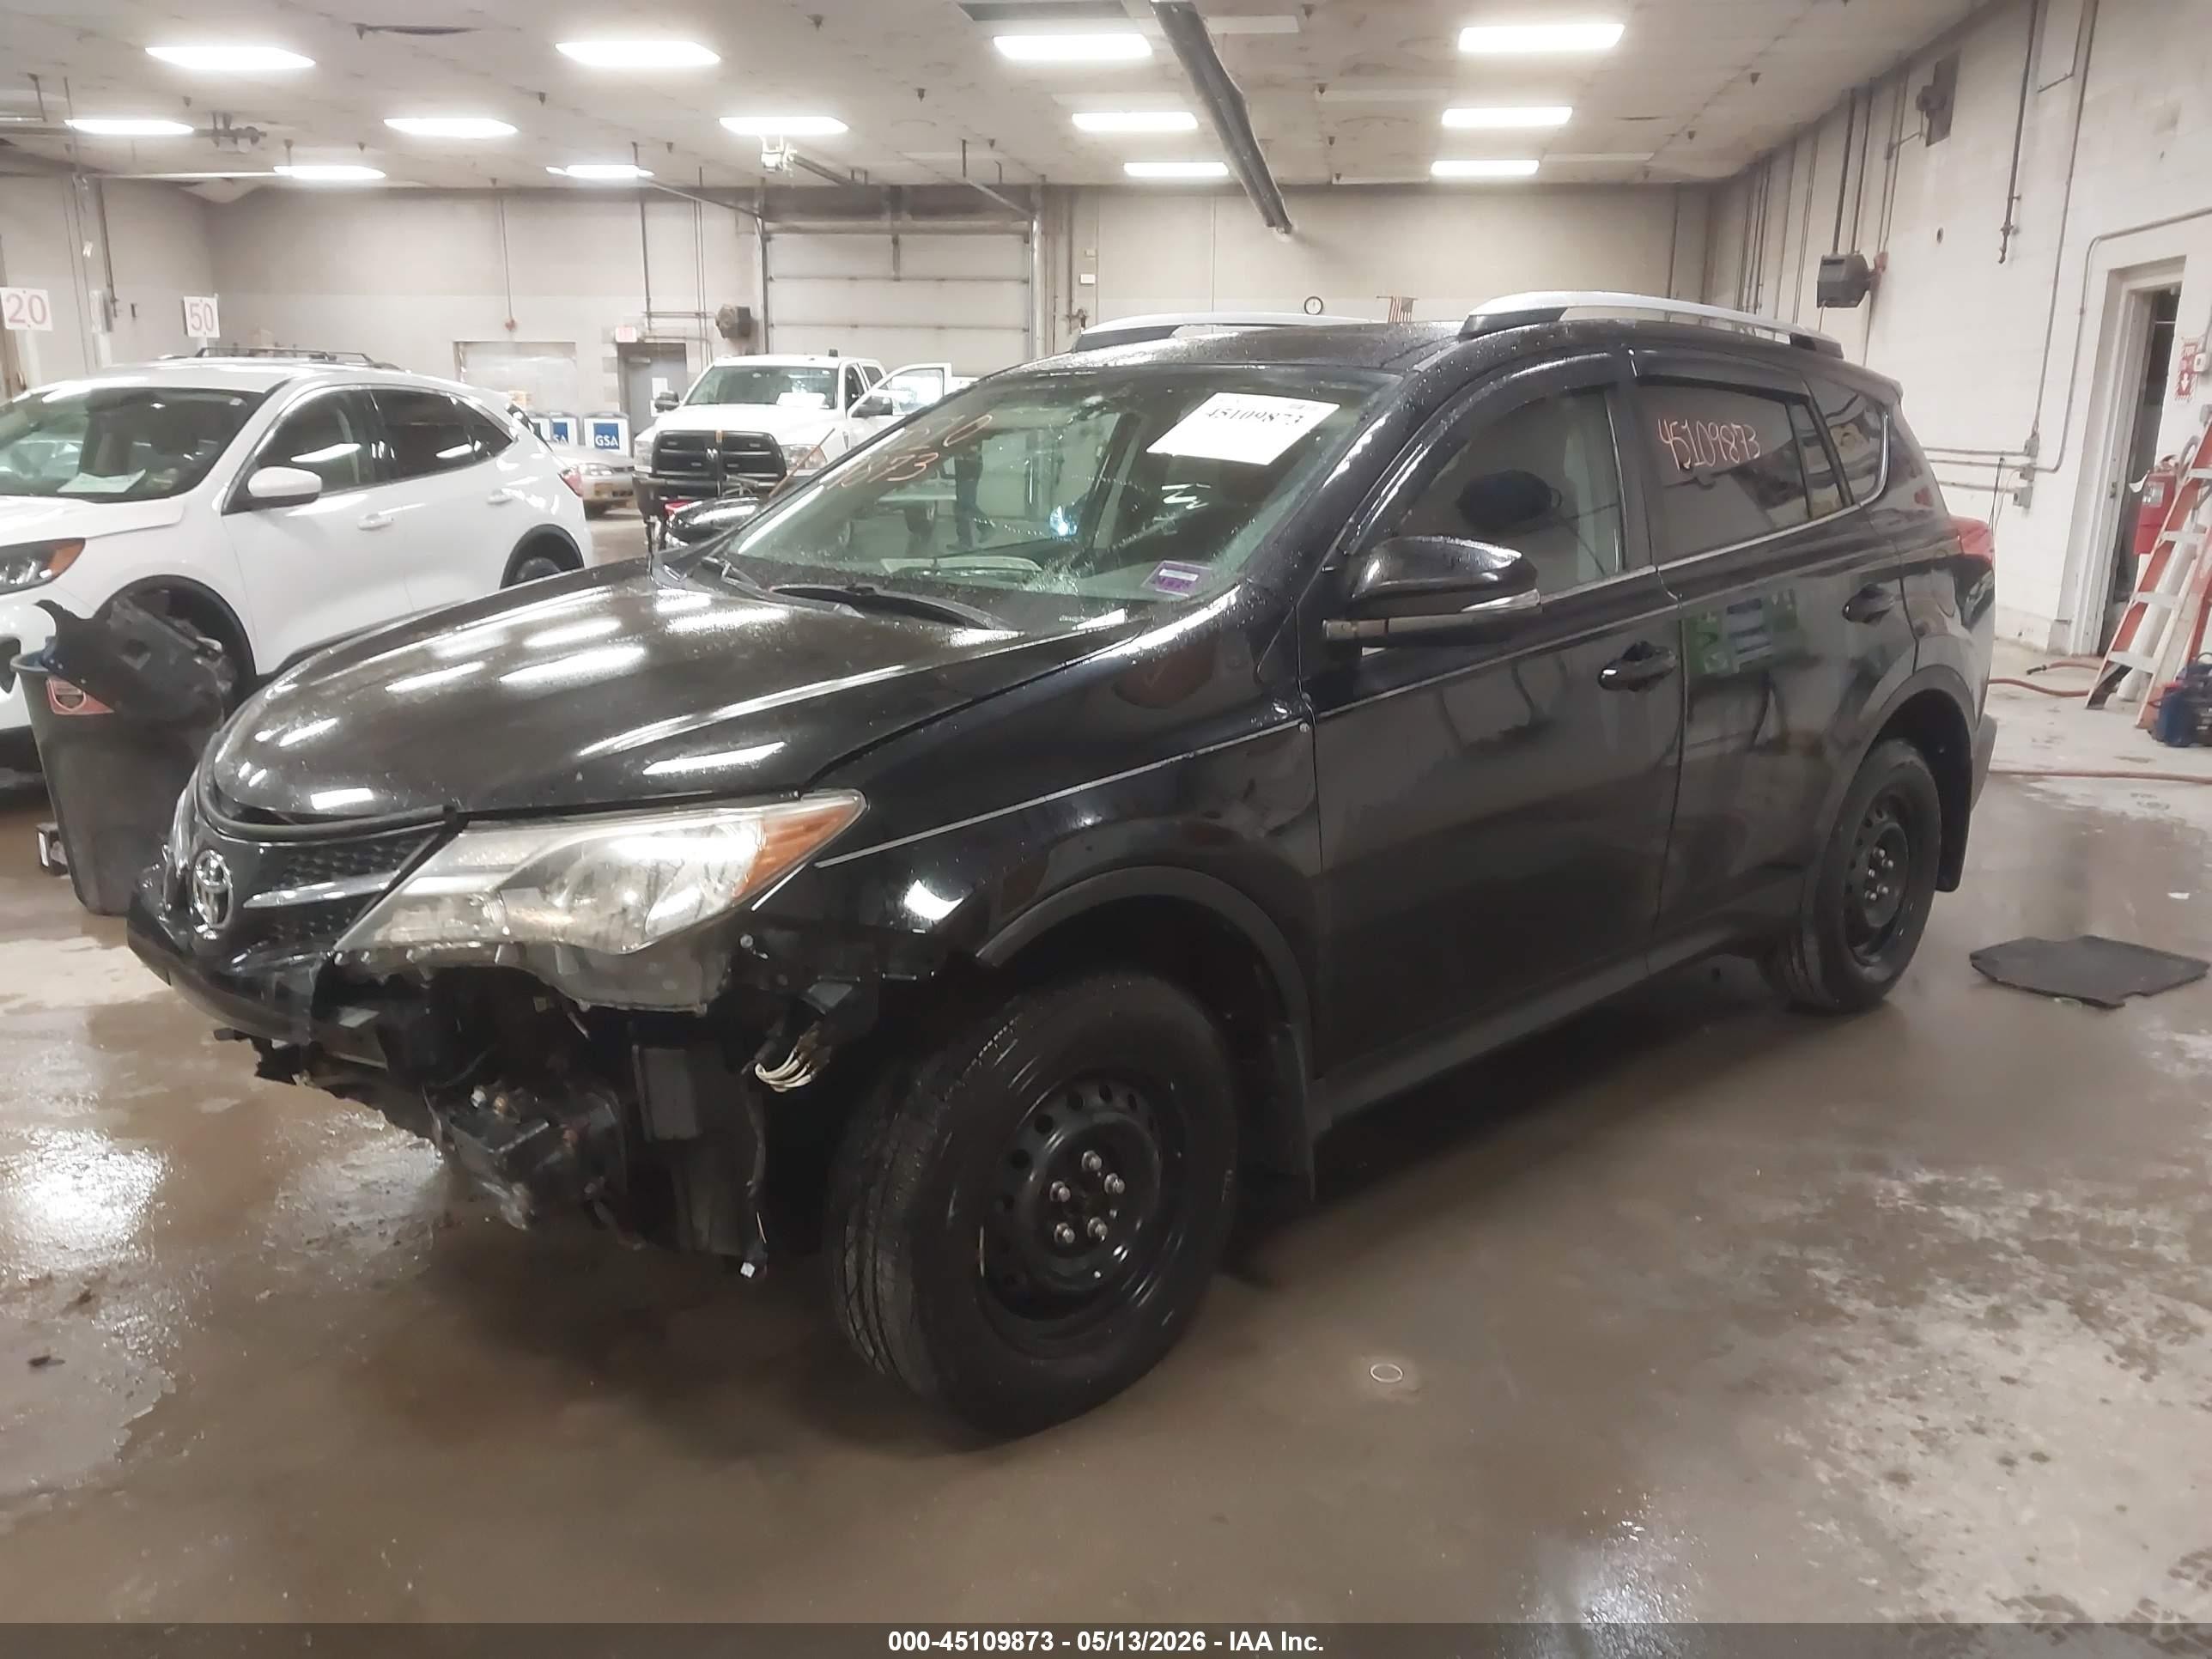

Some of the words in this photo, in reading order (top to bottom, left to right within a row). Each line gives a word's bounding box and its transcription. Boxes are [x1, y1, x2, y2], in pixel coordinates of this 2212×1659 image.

[6, 293, 47, 325] 20
[189, 301, 215, 332] 50
[1206, 407, 1304, 425] 45109873
[594, 434, 619, 447] GSA
[1656, 418, 1760, 471] 45109873
